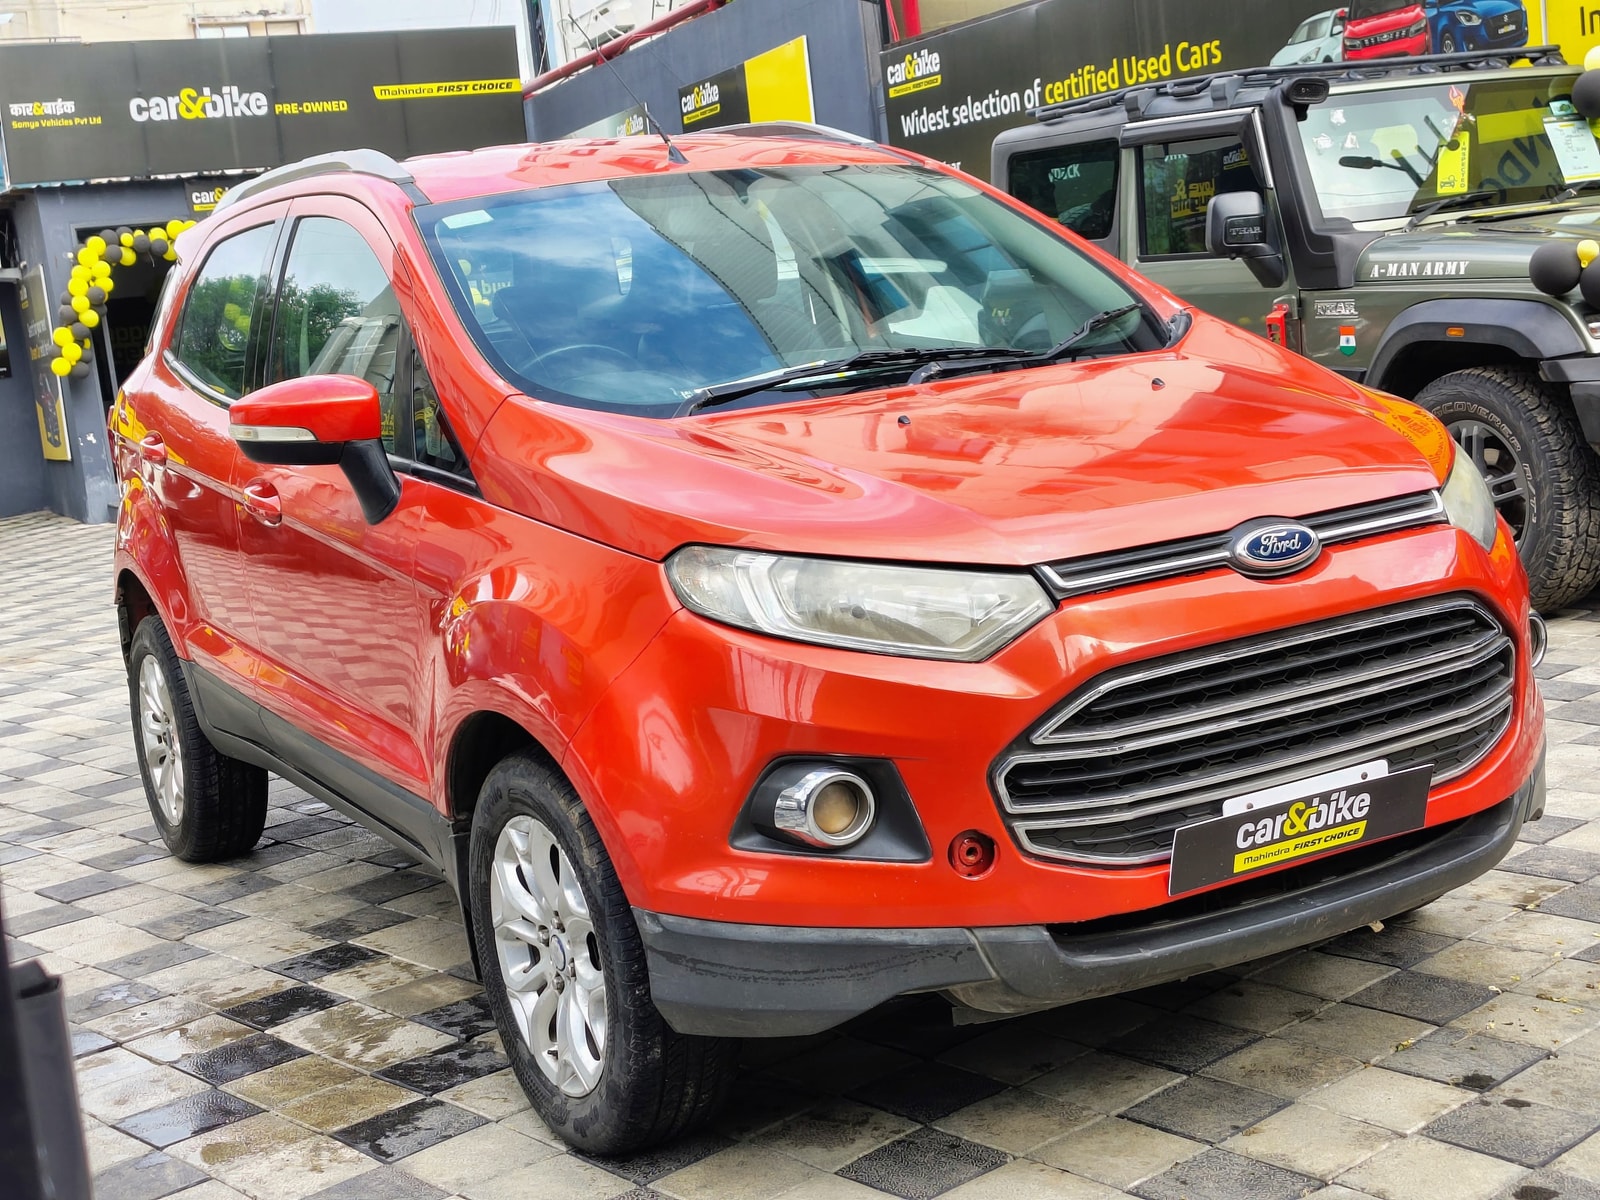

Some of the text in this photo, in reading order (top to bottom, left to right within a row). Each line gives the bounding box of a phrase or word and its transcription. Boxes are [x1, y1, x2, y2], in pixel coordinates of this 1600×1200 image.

[887, 49, 940, 84] car&bike
[129, 85, 348, 122] car&bike PRE-OWNED
[380, 81, 513, 96] Mahindra FIRST CHOICE
[681, 82, 719, 113] car&bike
[901, 40, 1222, 137] Widest selection of certified Used Cars
[41, 118, 73, 127] Vehicles
[1370, 261, 1469, 278] A-MAN ARMY
[1432, 401, 1522, 452] SCOVERER
[1260, 531, 1302, 556] Ford
[1236, 790, 1371, 849] car&bike
[1244, 827, 1360, 864] Mahindra FIRST CHOICE
